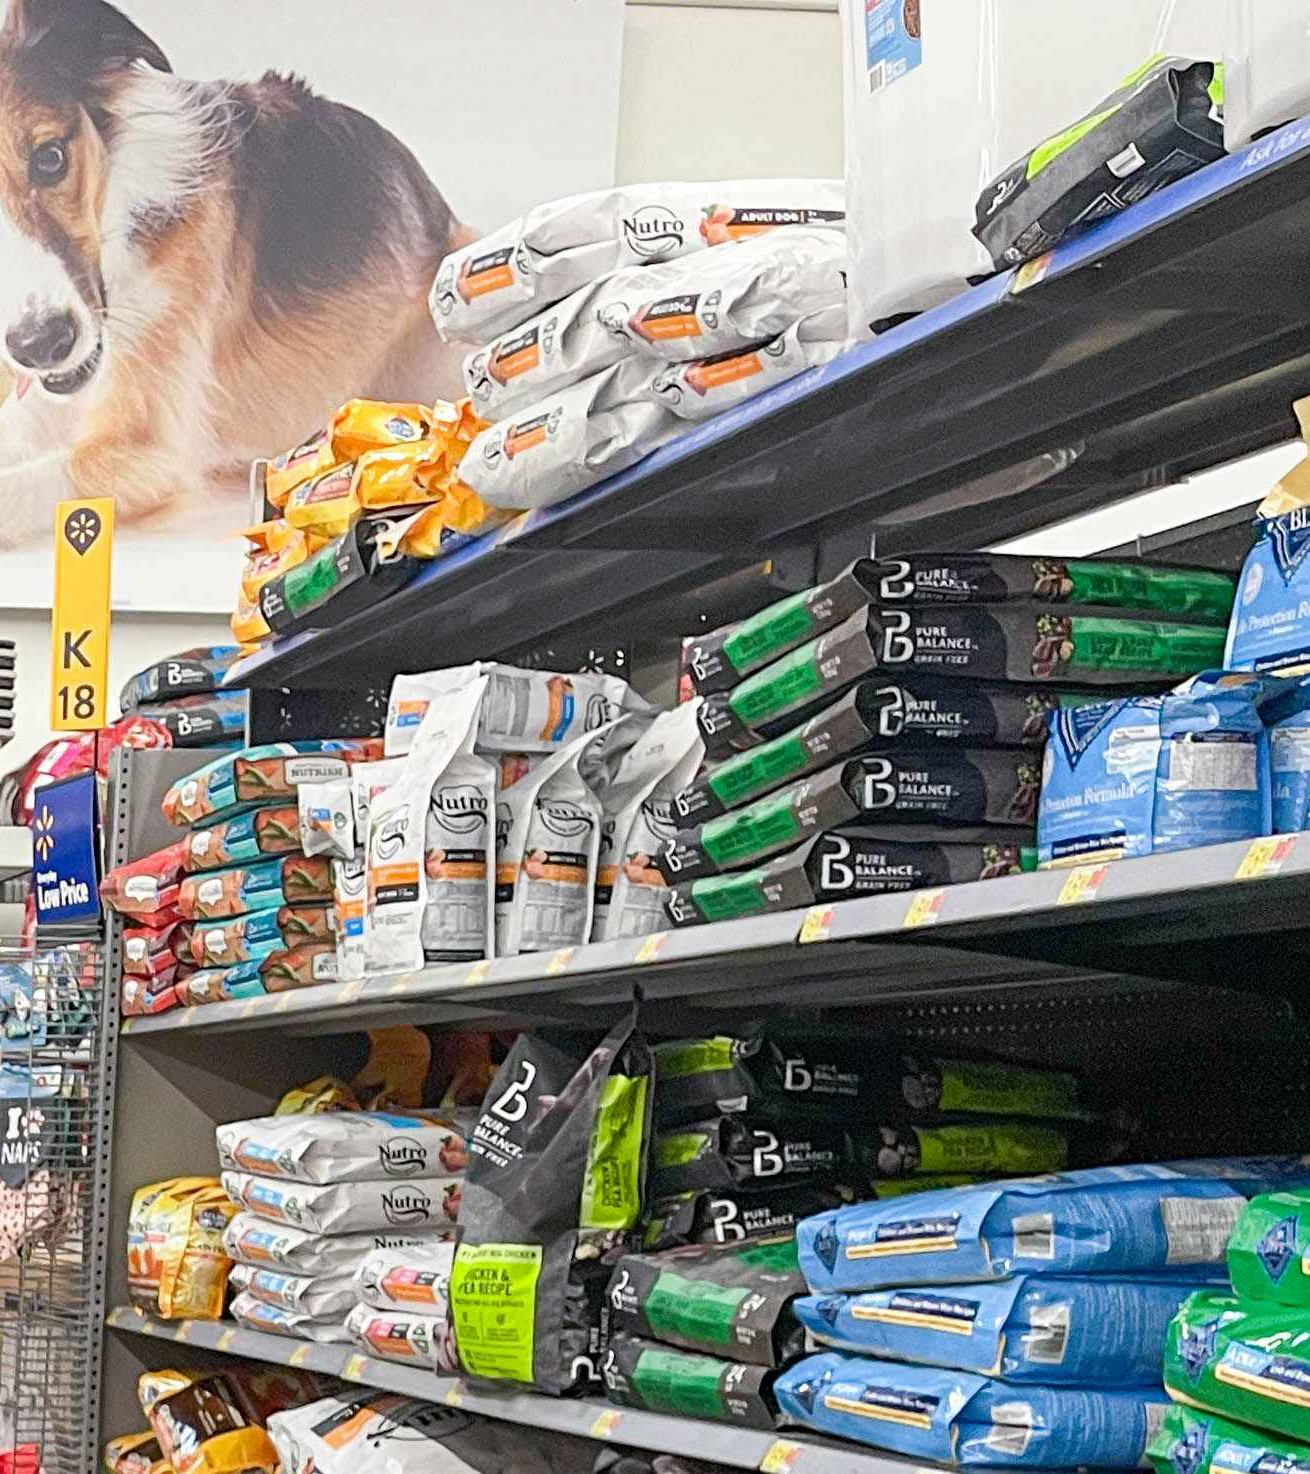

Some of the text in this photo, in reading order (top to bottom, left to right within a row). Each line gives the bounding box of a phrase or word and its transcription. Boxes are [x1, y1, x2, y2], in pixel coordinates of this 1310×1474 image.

[741, 211, 800, 223] ADULT DOG
[622, 216, 685, 243] Nutro
[915, 626, 948, 638] PURE
[63, 632, 92, 669] K
[916, 637, 975, 650] BALANCE
[58, 686, 95, 720] 18
[899, 772, 930, 785] PURE
[899, 784, 954, 798] BALANCE
[855, 854, 886, 867] PURE
[855, 865, 916, 877] BALANCE
[38, 881, 90, 911] Low Price
[480, 1114, 511, 1136] PURE
[1, 1141, 41, 1165] NAPS
[380, 1144, 427, 1164] Nutro
[382, 1193, 431, 1212] Nutro
